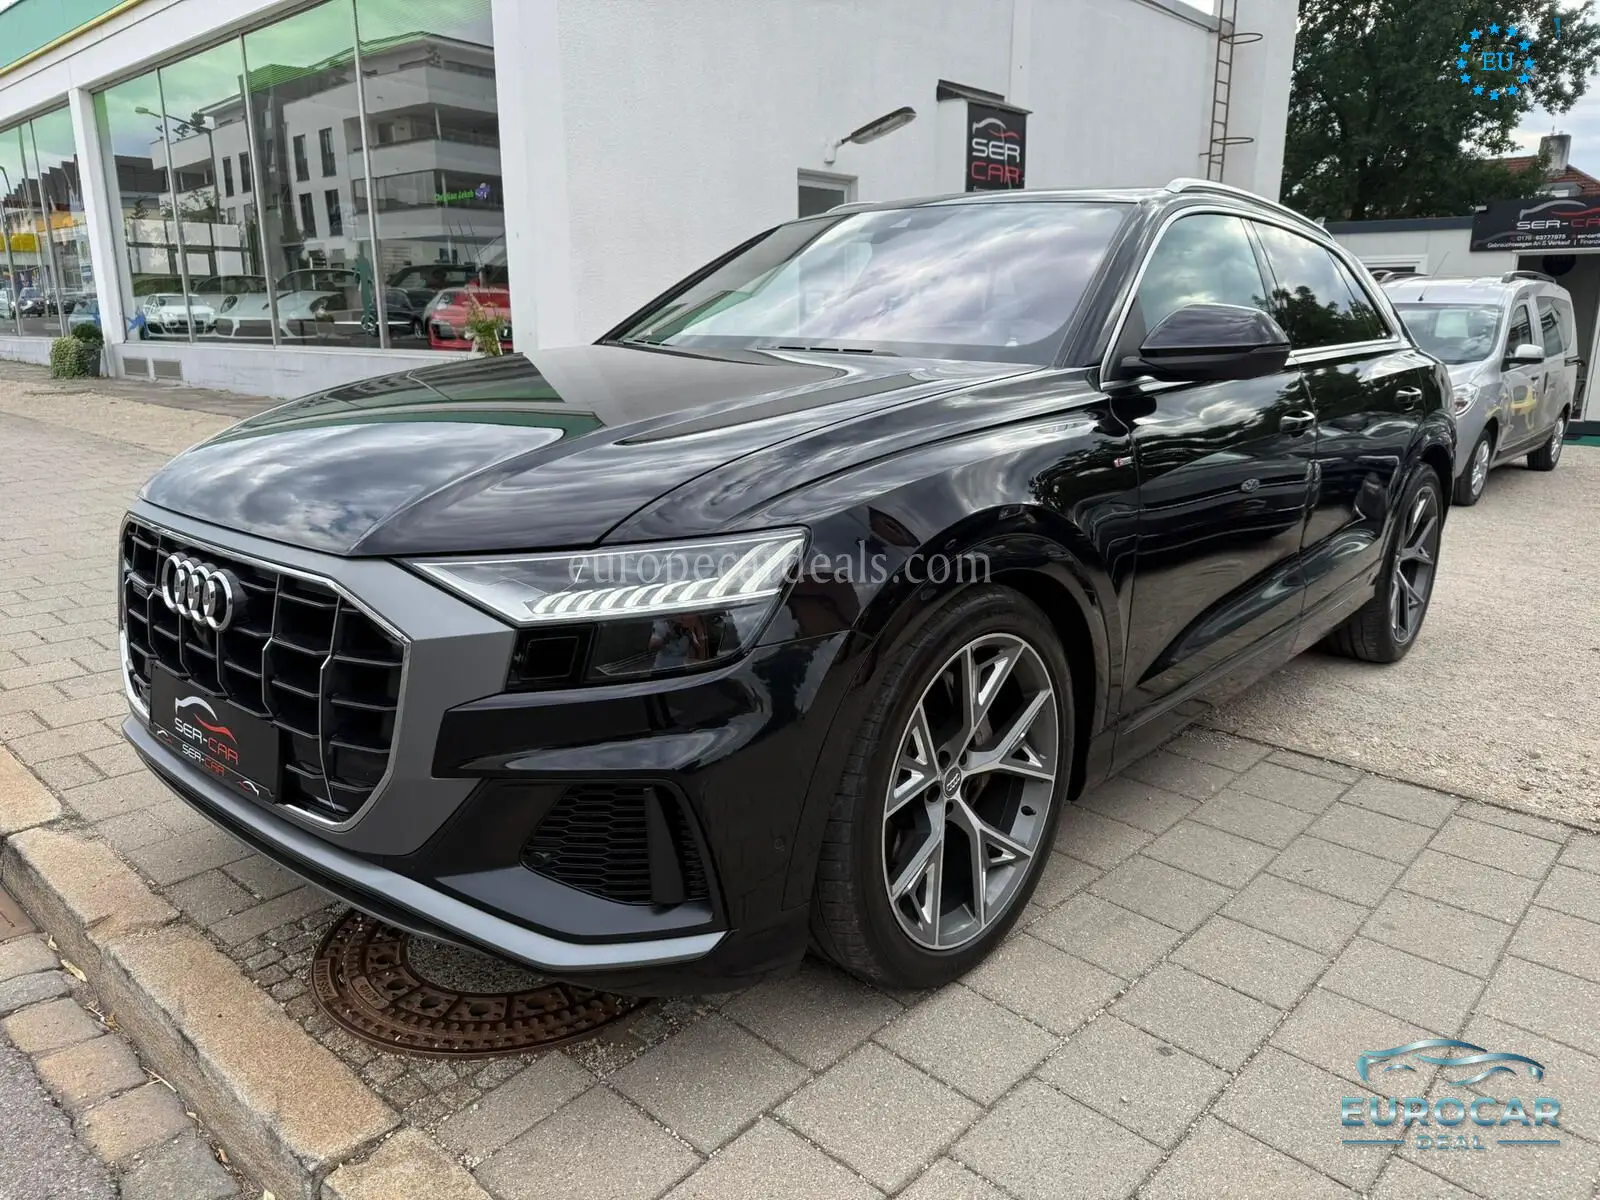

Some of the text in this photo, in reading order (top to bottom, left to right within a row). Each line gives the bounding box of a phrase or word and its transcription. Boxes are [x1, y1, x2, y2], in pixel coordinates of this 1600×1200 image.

[972, 138, 1020, 163] SER
[971, 161, 1020, 185] CAR
[174, 717, 239, 766] SER-CAR
[182, 743, 225, 776] SER-CAR
